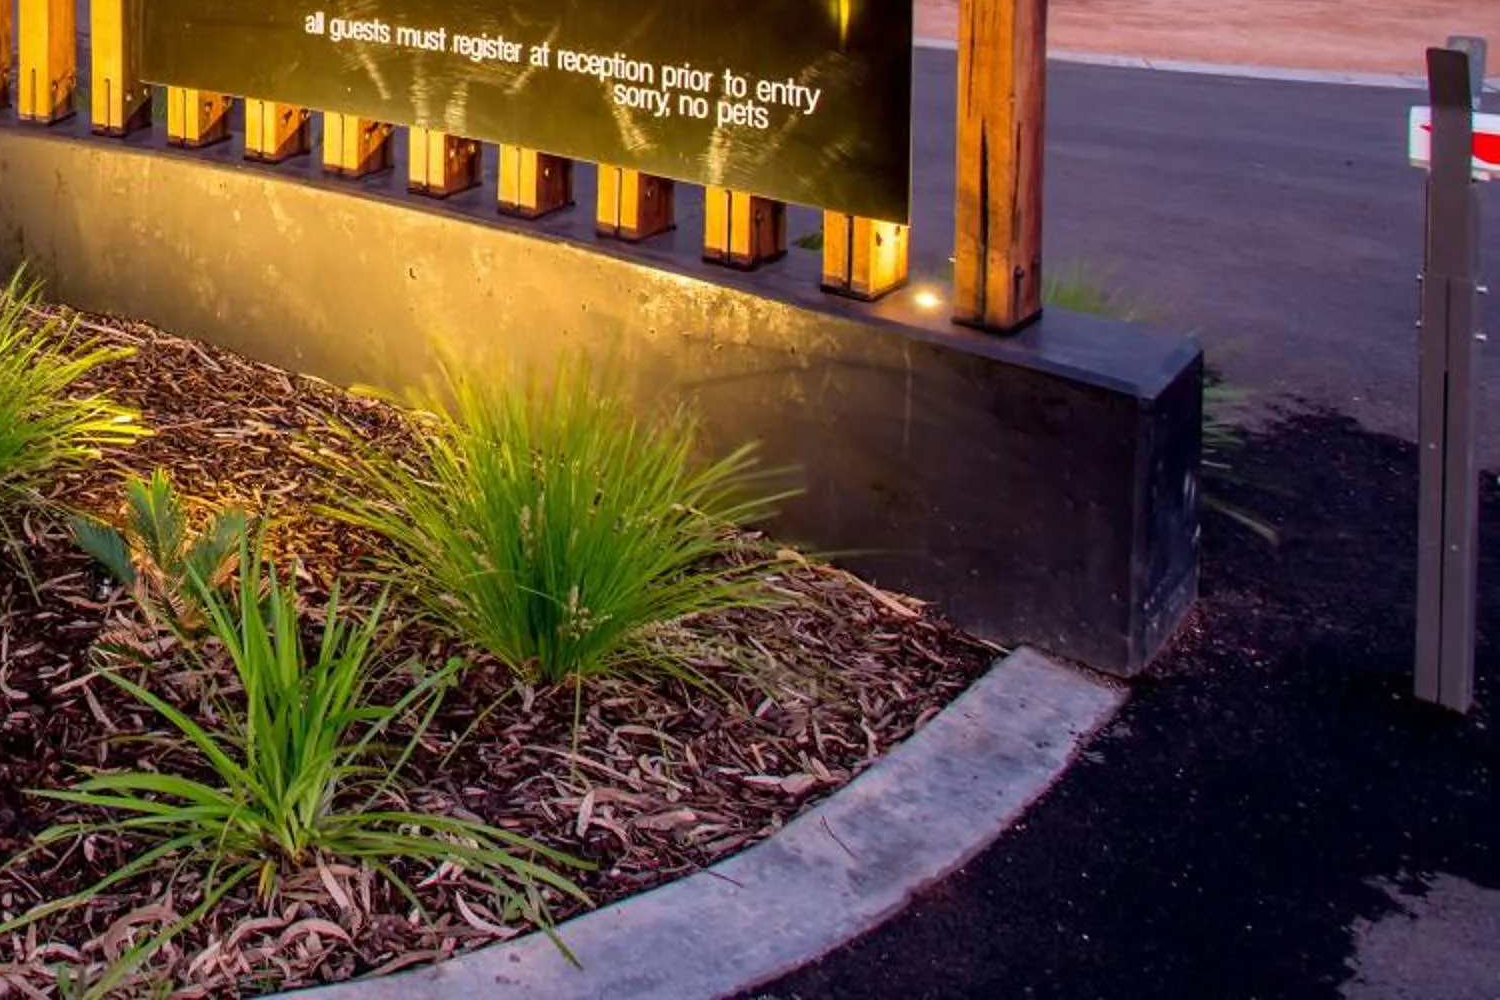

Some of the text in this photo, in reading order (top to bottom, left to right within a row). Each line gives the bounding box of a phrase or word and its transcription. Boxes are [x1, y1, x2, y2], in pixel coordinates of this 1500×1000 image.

[305, 12, 821, 115] all guests must register at reception prior to entry
[613, 83, 770, 129] sorry, no pets
